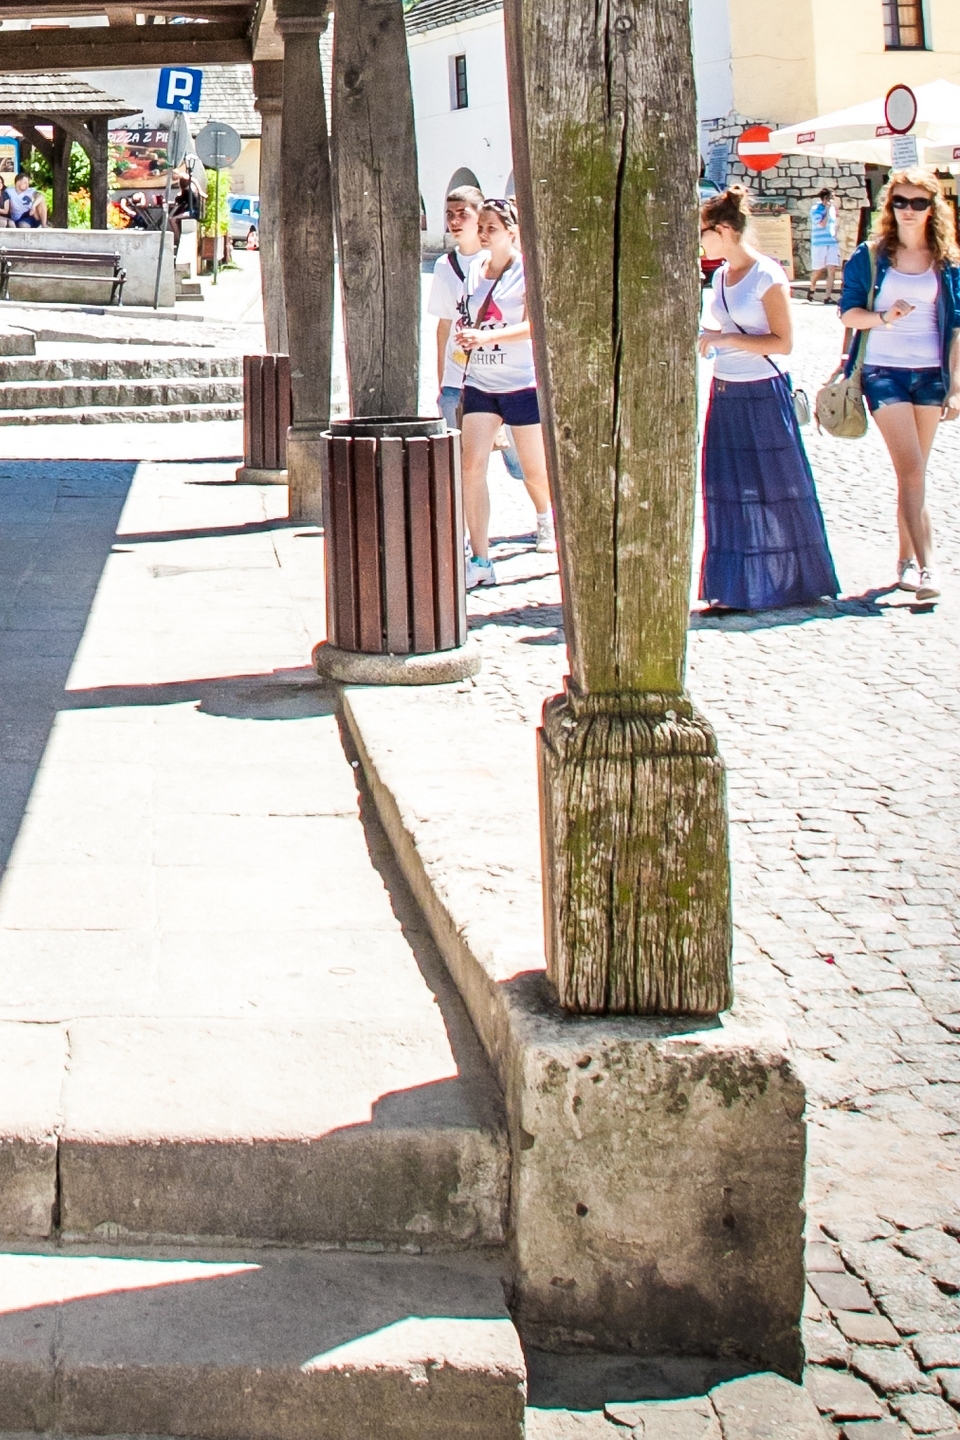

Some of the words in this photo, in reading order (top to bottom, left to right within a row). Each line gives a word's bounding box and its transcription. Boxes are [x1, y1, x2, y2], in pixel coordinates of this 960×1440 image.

[166, 70, 194, 105] P
[107, 132, 140, 144] PIZZA
[142, 132, 153, 143] Z
